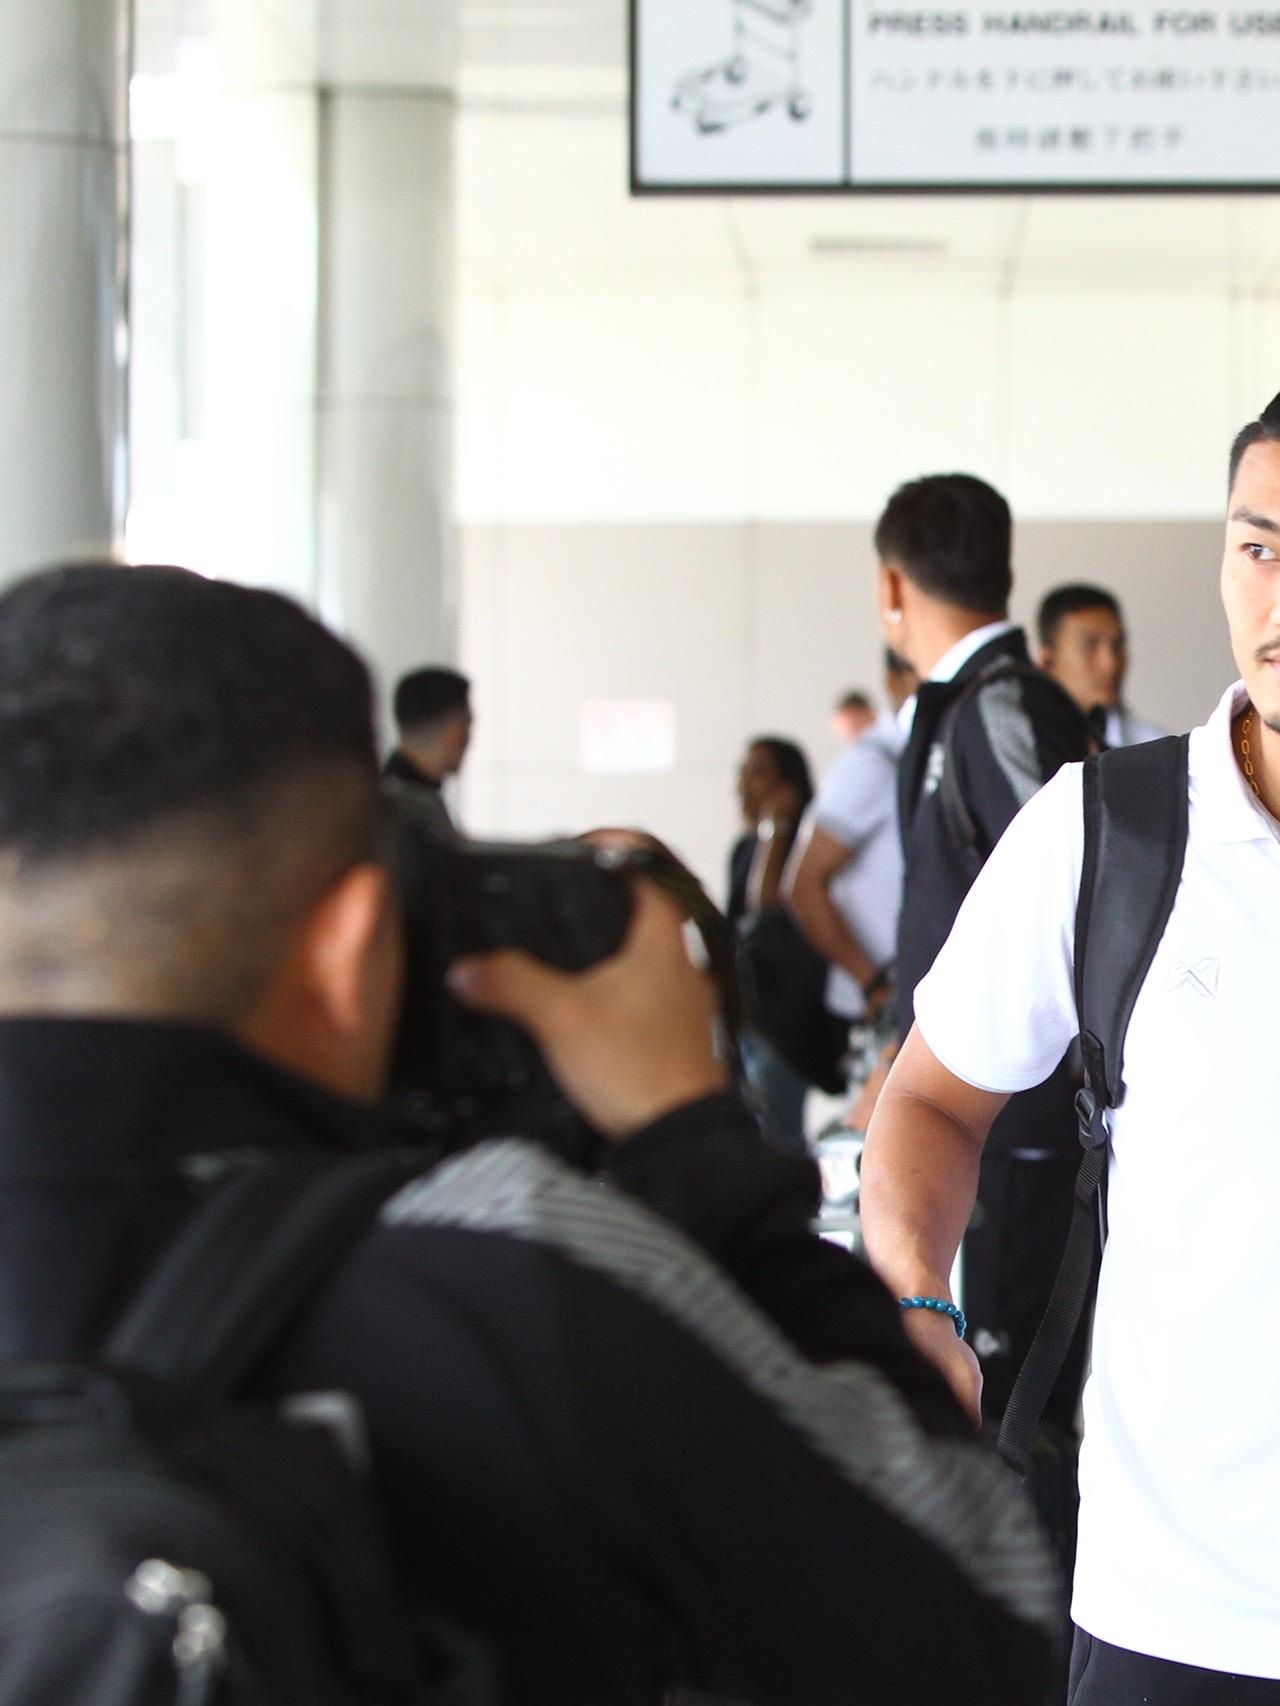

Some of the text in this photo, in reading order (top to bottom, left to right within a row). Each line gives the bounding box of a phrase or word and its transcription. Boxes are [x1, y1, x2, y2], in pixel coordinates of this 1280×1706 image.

[868, 12, 968, 36] PRESS
[983, 12, 1137, 36] HANDRAIL
[1154, 11, 1216, 35] FOR
